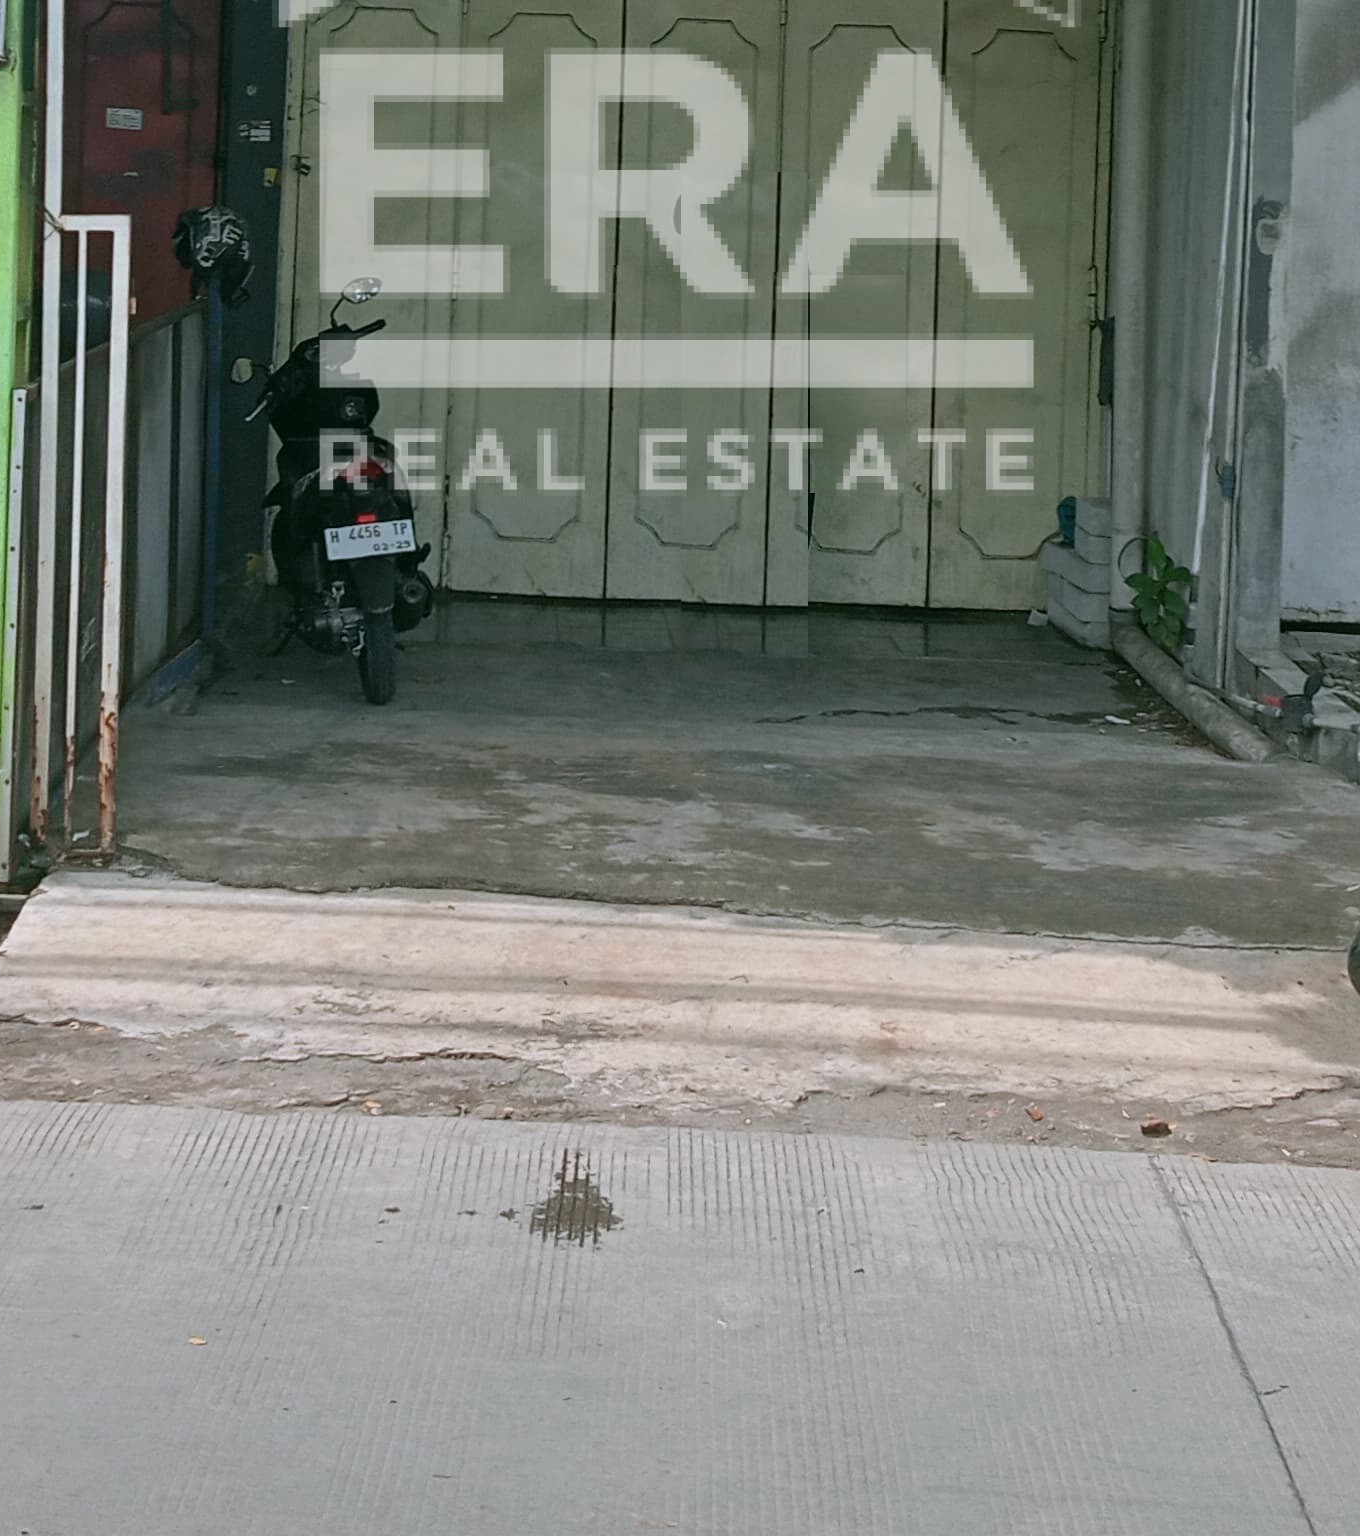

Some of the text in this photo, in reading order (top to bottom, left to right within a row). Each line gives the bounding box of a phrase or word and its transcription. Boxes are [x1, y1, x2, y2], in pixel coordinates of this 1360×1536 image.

[330, 522, 408, 543] H 4456 TP
